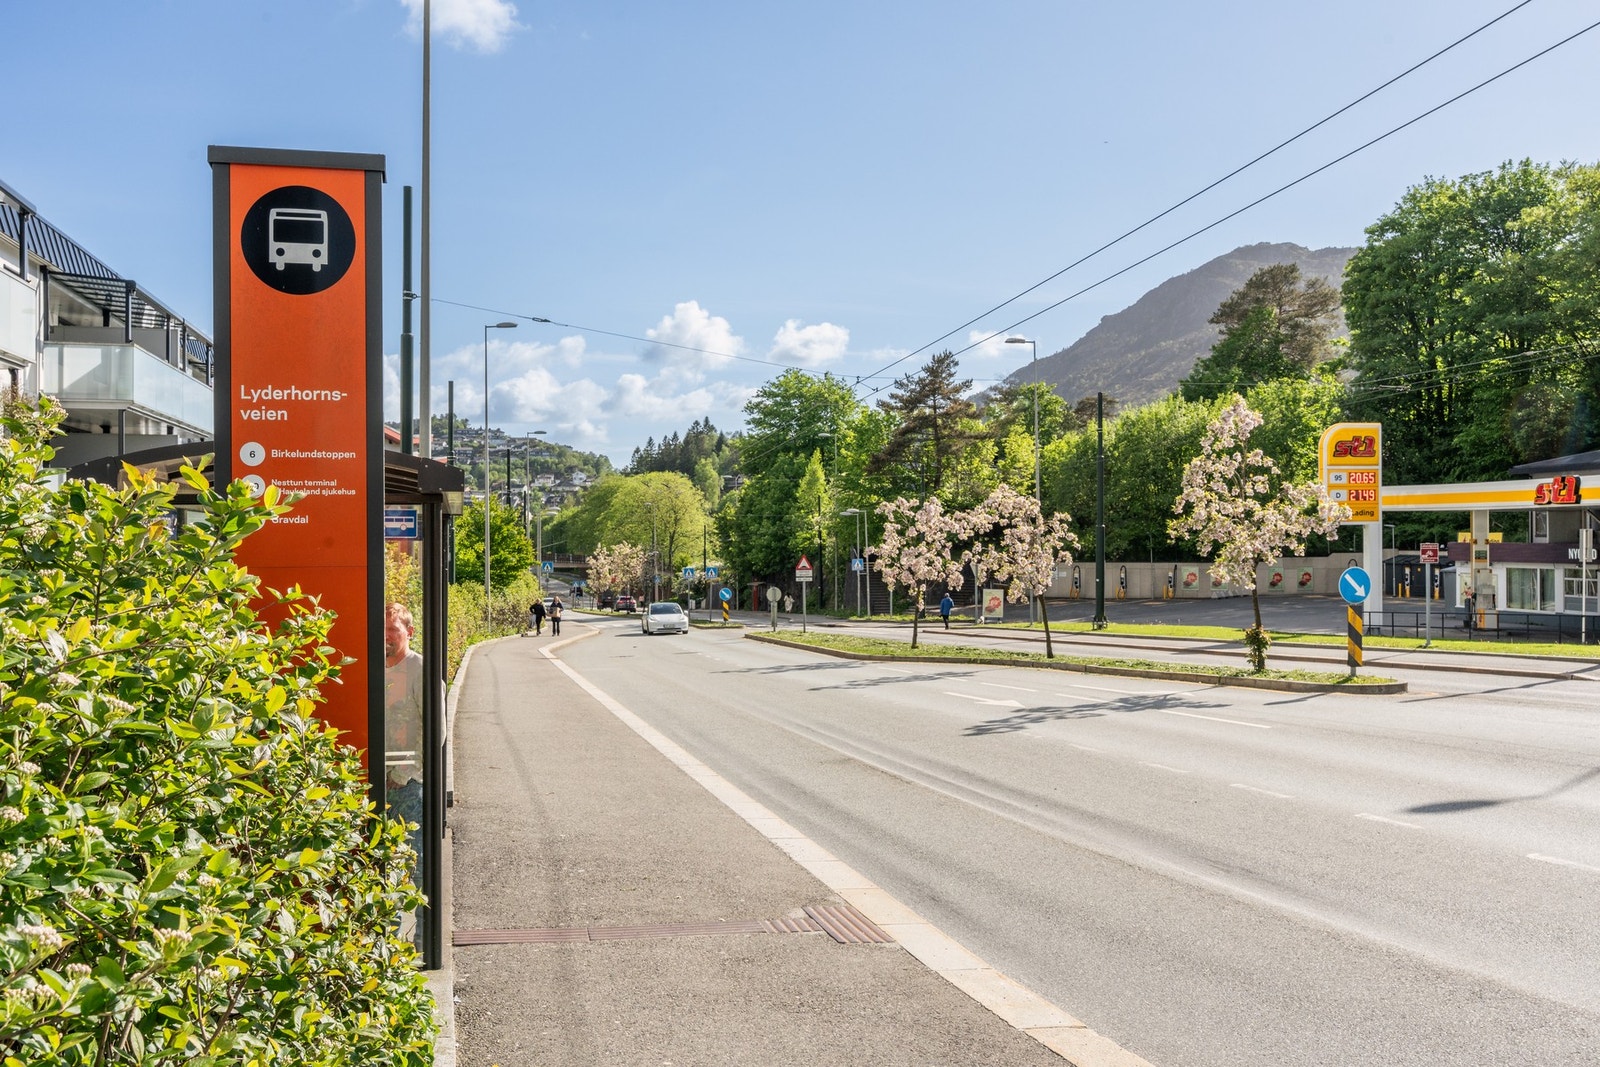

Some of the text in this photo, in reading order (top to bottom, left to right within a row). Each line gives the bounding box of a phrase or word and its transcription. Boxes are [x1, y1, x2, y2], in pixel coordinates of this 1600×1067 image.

[240, 385, 347, 402] Lyderhorns-
[240, 406, 288, 421] veien
[1333, 436, 1376, 457] st1
[249, 450, 256, 458] 6
[271, 449, 356, 460] Birkelundstoppen
[271, 478, 337, 486] Nesttun terminal
[321, 488, 356, 496] sjukehus
[271, 514, 309, 524] Gravdal
